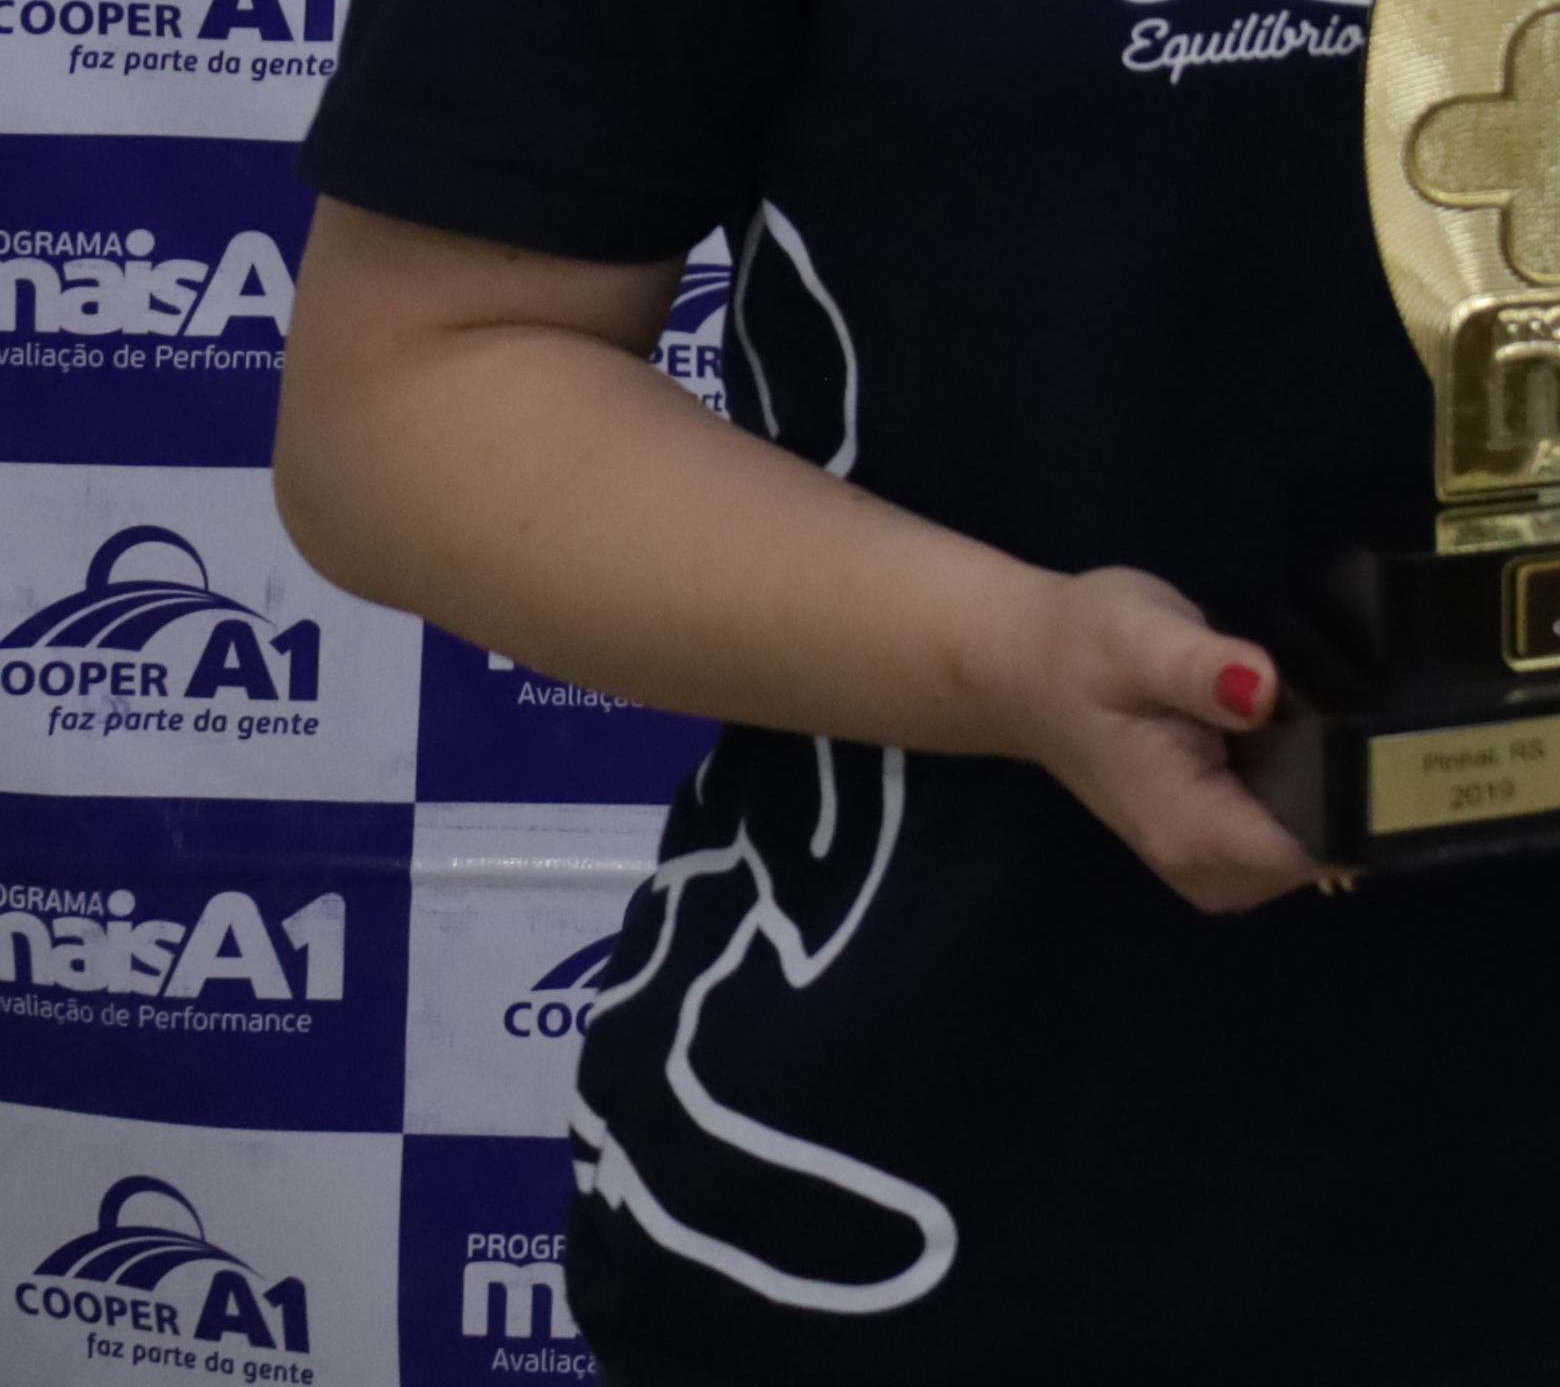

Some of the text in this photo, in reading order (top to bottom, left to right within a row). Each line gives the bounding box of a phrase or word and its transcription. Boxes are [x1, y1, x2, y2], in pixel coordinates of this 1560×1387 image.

[69, 45, 335, 81] faz parte da gente
